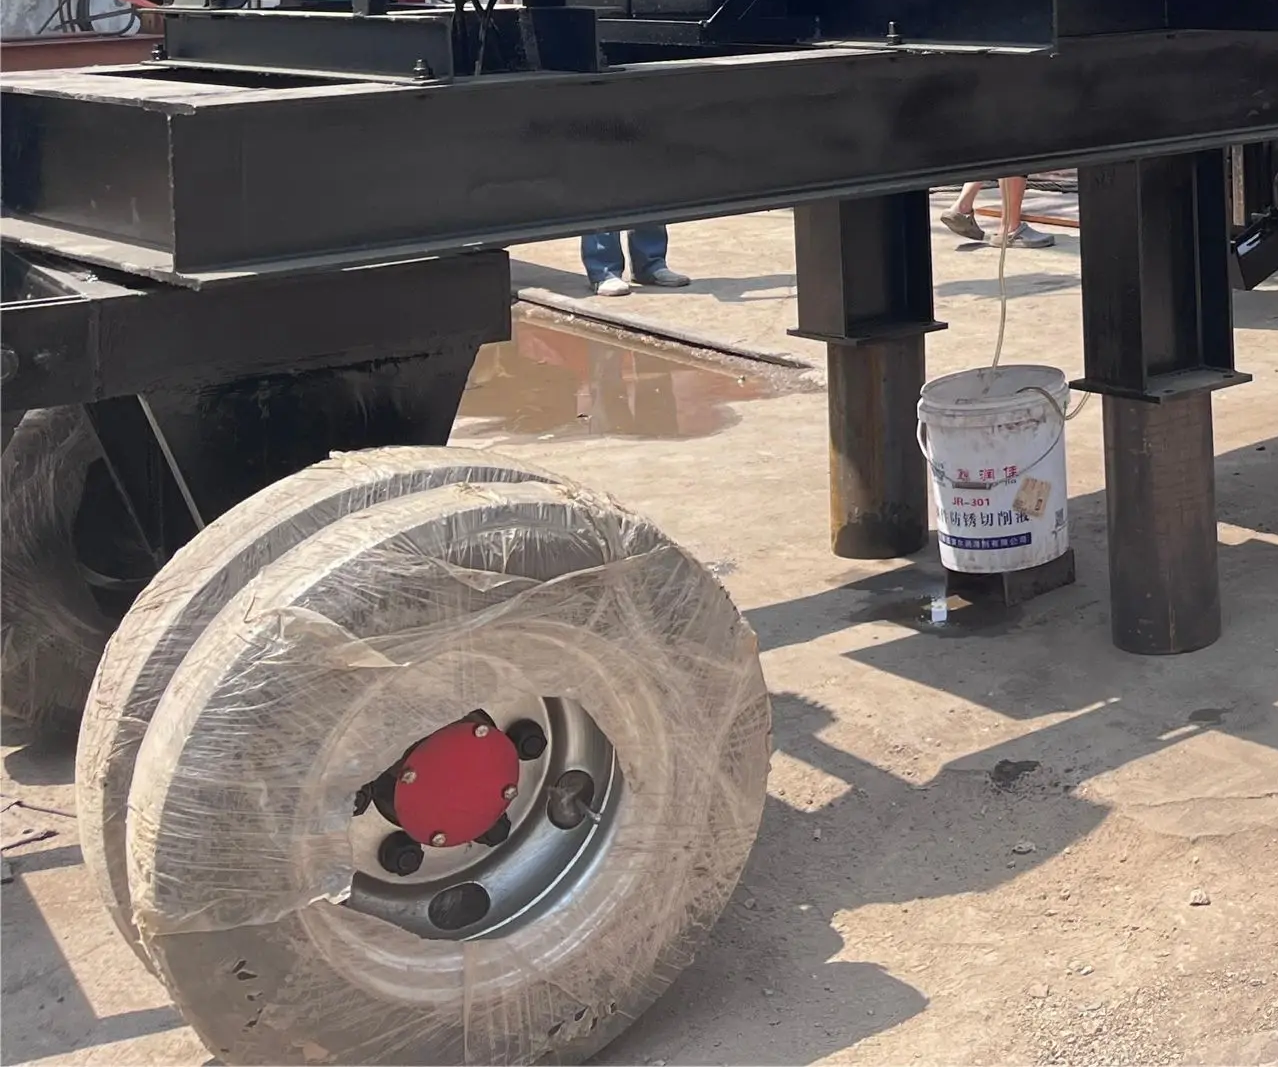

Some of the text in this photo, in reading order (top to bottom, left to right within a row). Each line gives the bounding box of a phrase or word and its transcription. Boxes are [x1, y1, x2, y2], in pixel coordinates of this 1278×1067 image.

[952, 496, 991, 507] JR-301
[940, 510, 1030, 528] 防锈切削液
